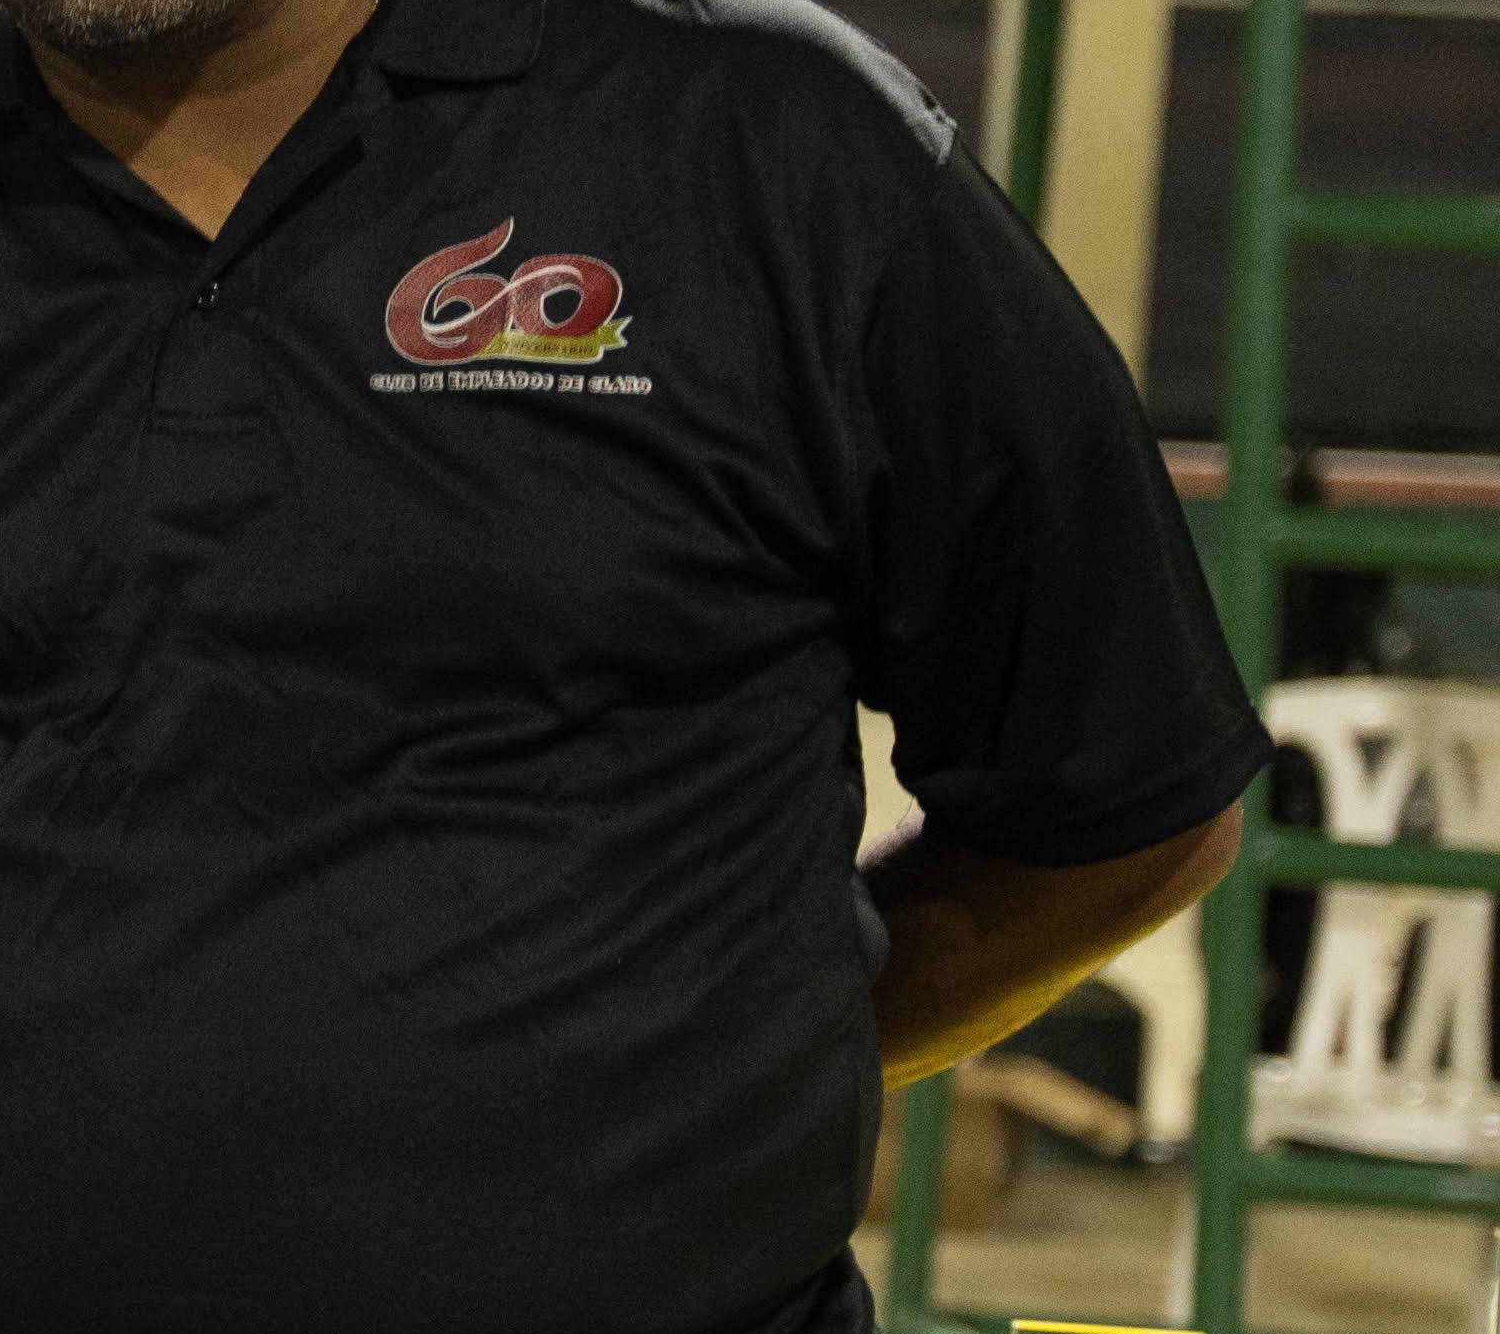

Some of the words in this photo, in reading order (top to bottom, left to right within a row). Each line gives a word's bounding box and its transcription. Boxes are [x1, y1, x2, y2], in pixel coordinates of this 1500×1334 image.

[386, 216, 623, 365] 60
[369, 372, 416, 392] CLUB
[419, 371, 444, 392] DE
[448, 369, 554, 391] EMPLEADOS
[558, 374, 583, 393] DE
[587, 375, 652, 395] CLARO
